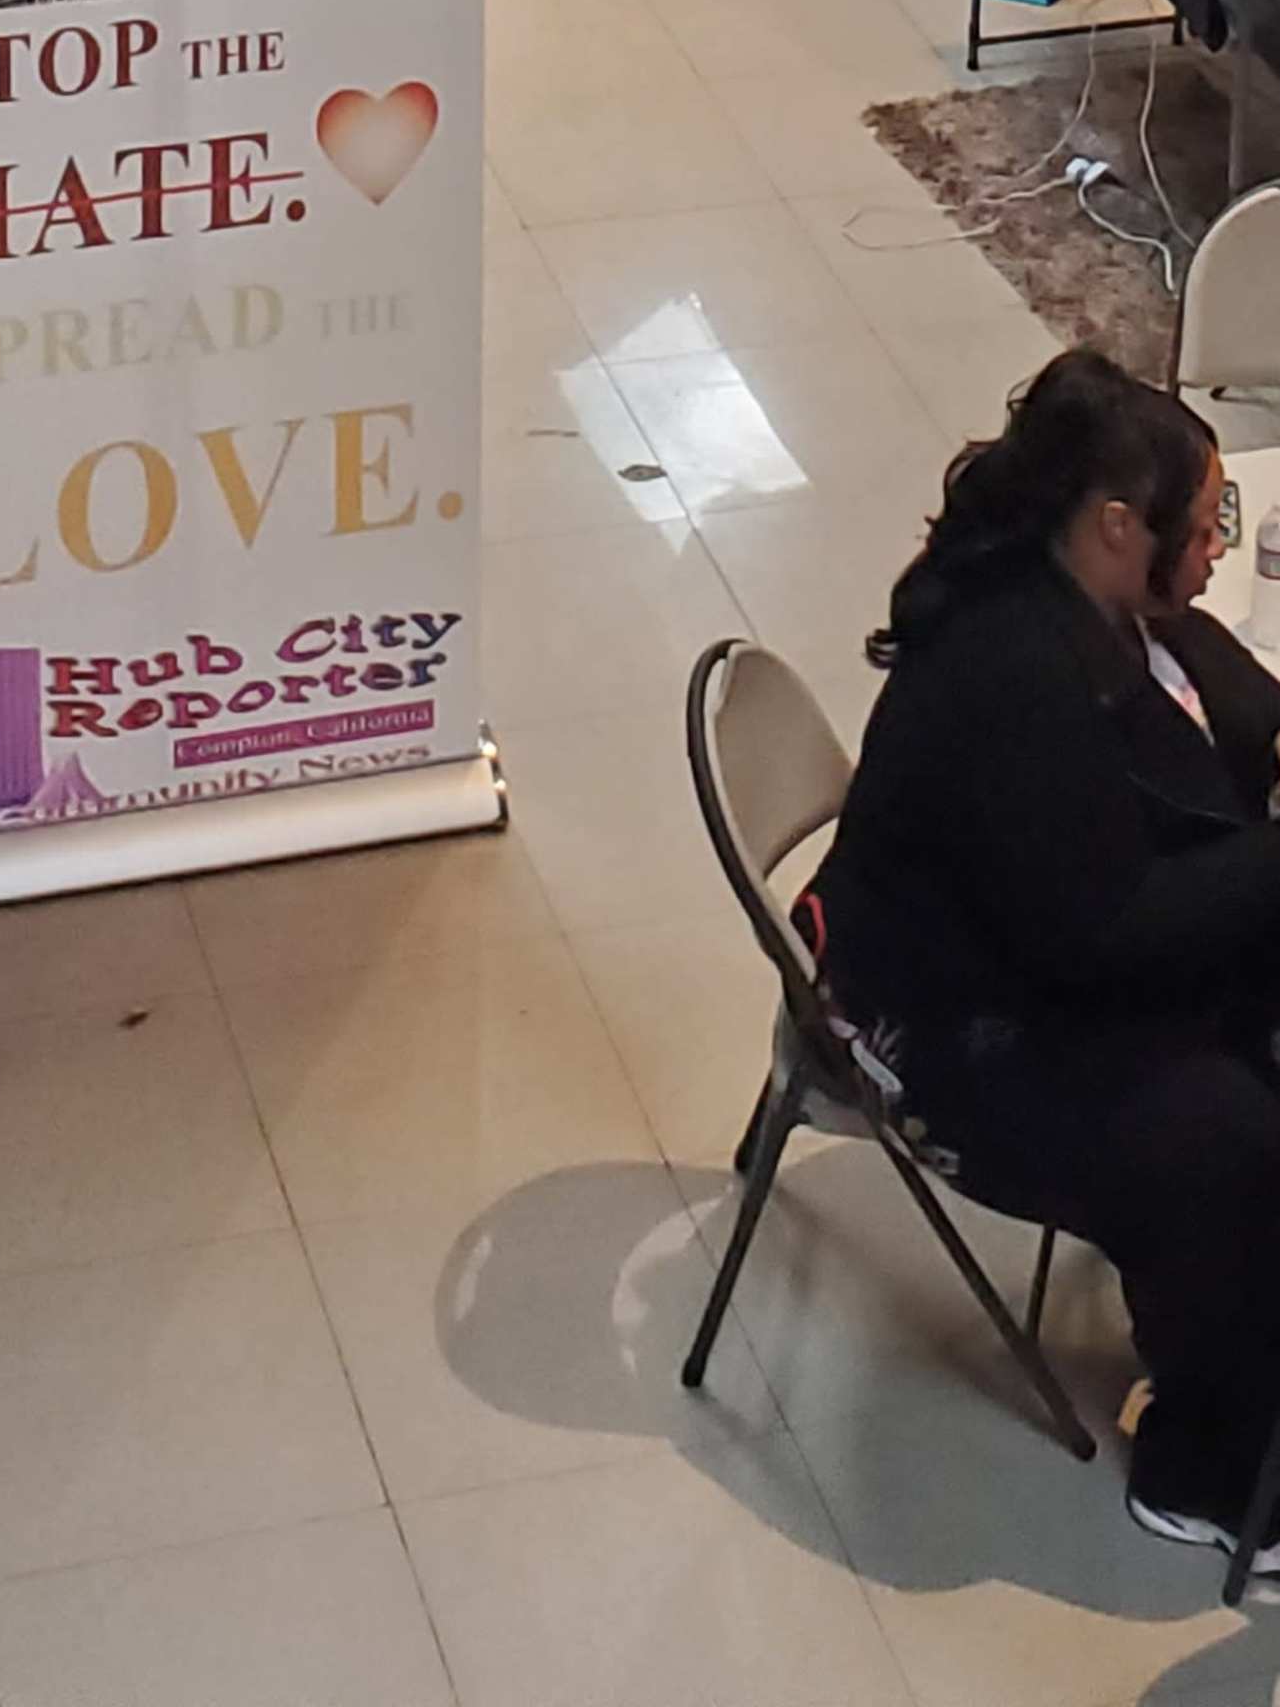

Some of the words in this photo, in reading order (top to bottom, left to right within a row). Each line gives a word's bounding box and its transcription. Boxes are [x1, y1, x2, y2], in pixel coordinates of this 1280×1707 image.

[181, 32, 285, 80] THE
[319, 290, 406, 339] THE
[46, 636, 244, 695] Hub
[276, 612, 462, 662] City
[47, 653, 447, 738] Reporter
[306, 705, 431, 741] California
[297, 743, 433, 780] News
